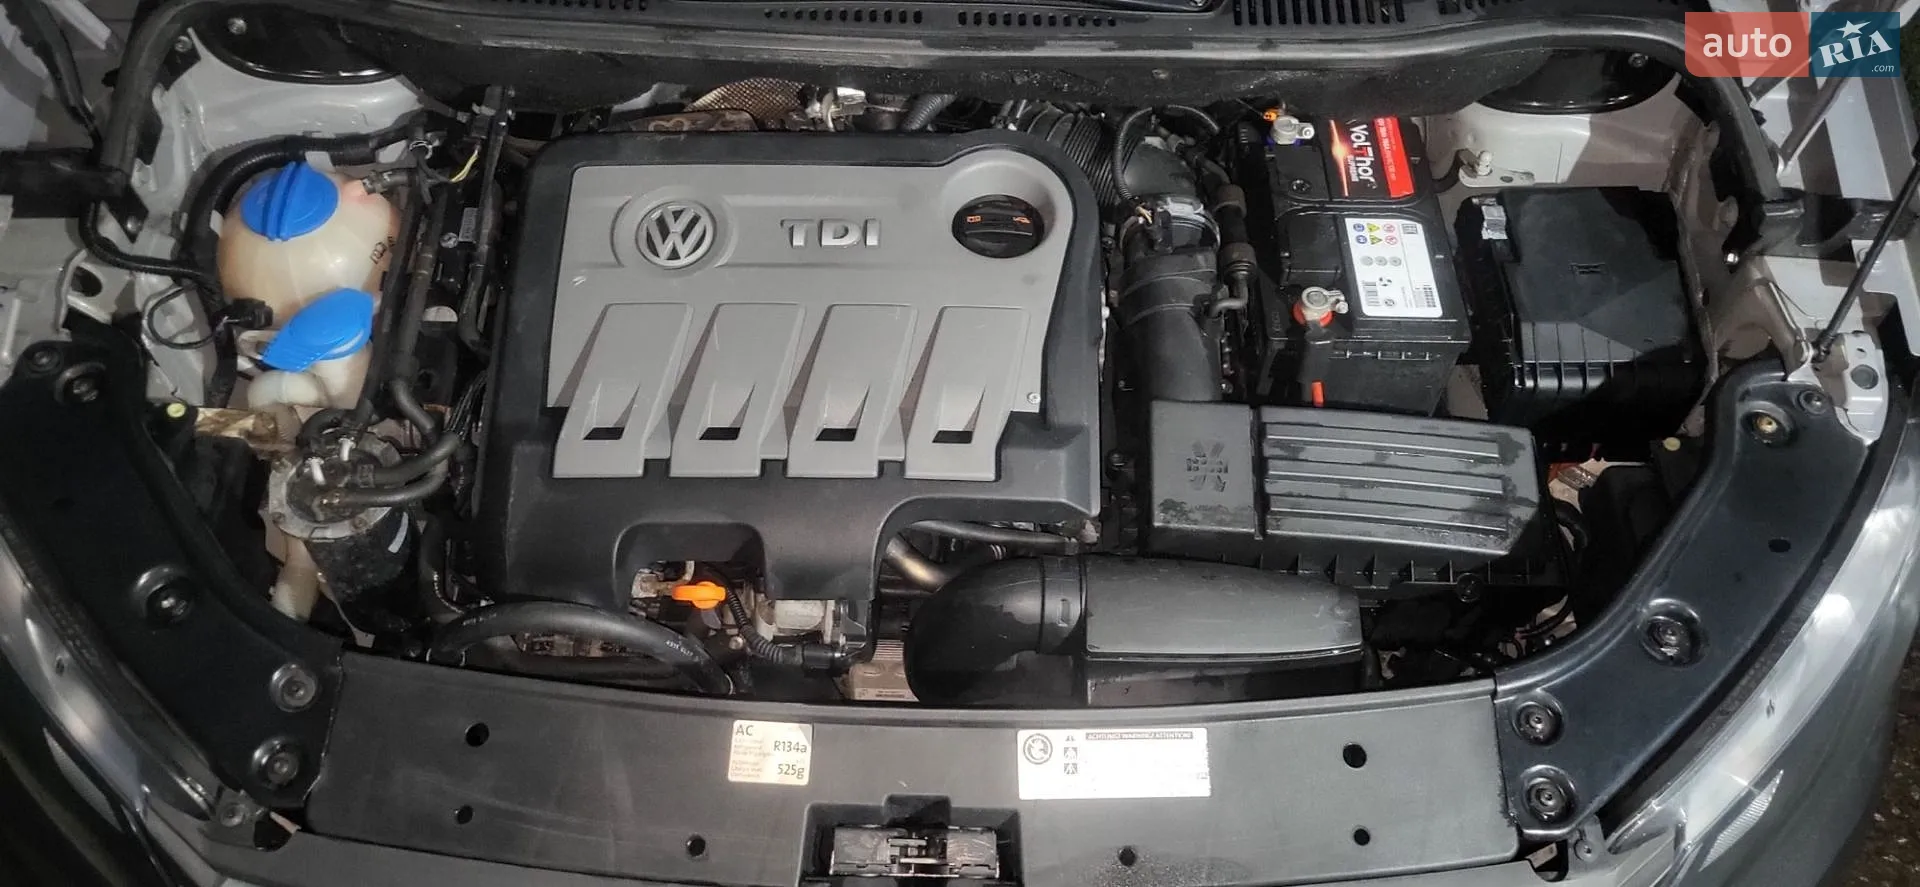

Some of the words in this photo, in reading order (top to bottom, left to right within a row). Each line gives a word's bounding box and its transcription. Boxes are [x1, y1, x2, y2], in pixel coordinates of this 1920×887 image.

[780, 218, 881, 248] TDI
[735, 724, 754, 736] AC
[773, 740, 808, 753] R134a
[777, 763, 805, 780] 525g
